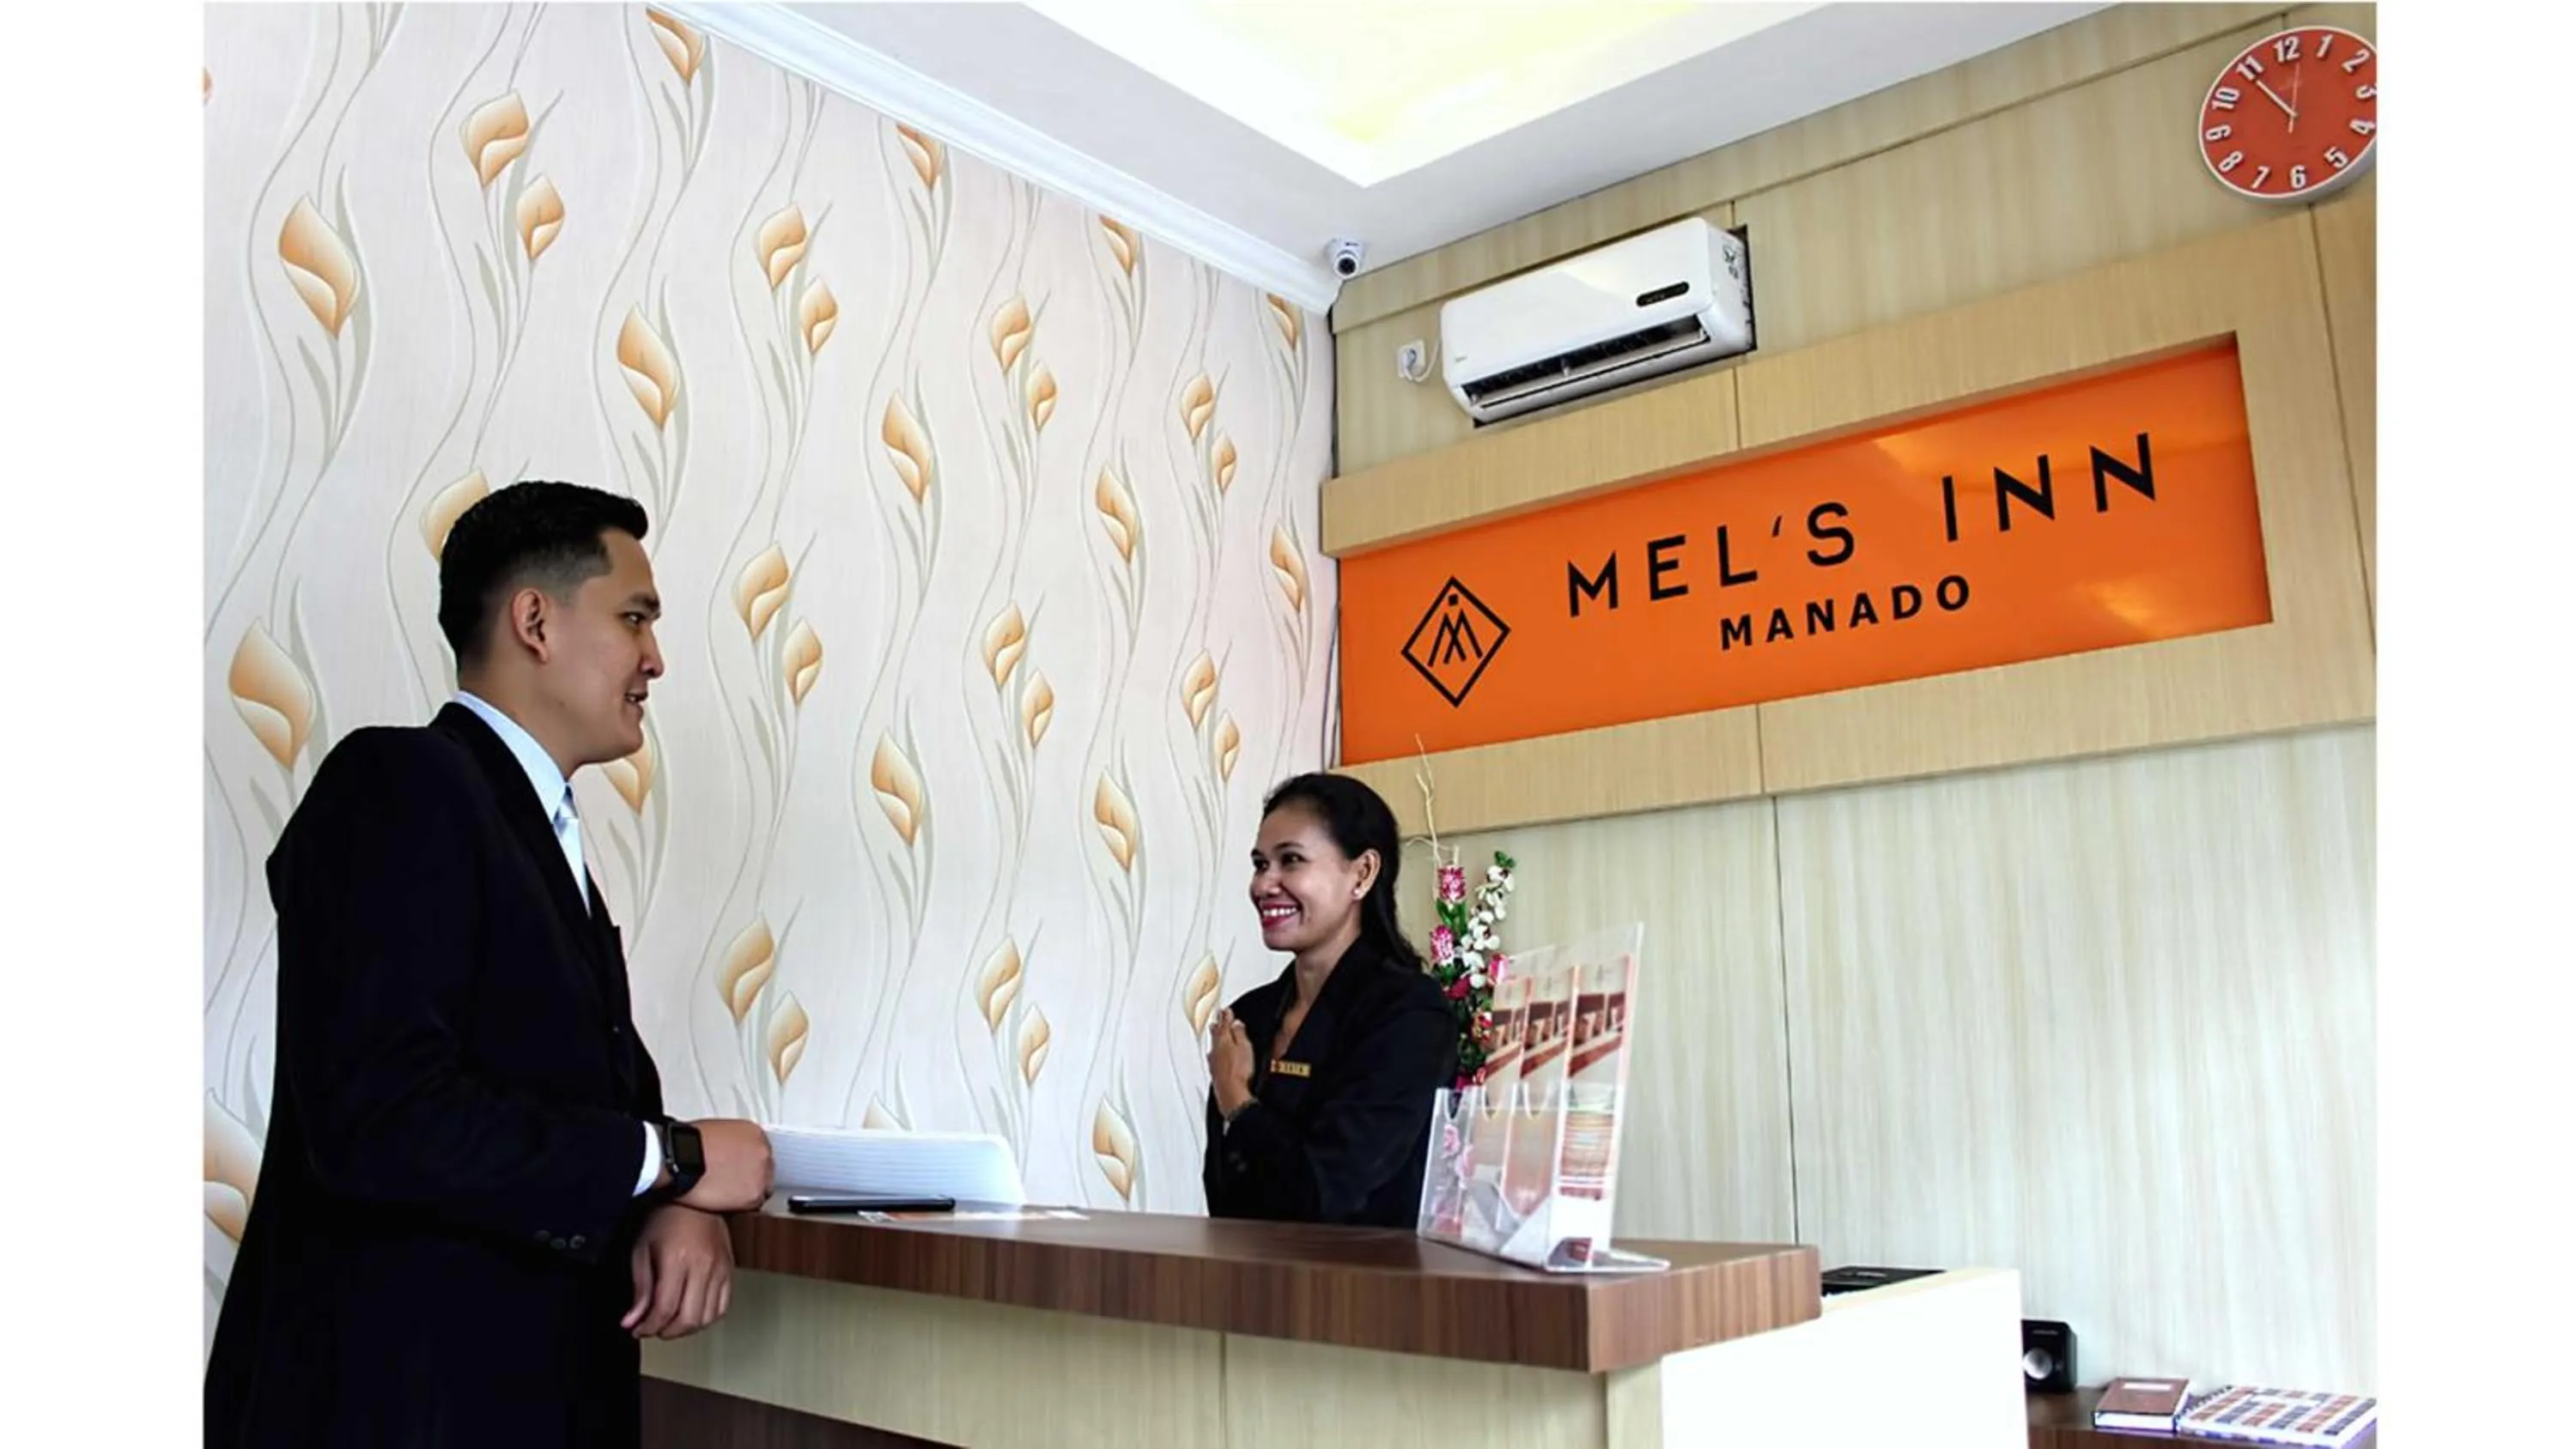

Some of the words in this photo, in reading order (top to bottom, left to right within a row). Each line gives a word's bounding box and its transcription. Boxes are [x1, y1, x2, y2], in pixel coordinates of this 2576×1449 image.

[2274, 36, 2300, 63] 12
[2317, 34, 2334, 58] 1
[2234, 55, 2265, 81] 11
[2342, 49, 2370, 72] 2
[2211, 87, 2240, 110] 10
[2349, 118, 2376, 136] 4
[2218, 151, 2243, 173] 8
[2324, 146, 2348, 168] 5
[2251, 165, 2270, 189] 7
[2290, 164, 2307, 188] 6
[1567, 501, 1856, 618] MEL'S
[1941, 432, 2156, 543] INN
[1720, 575, 1970, 651] MANADO
